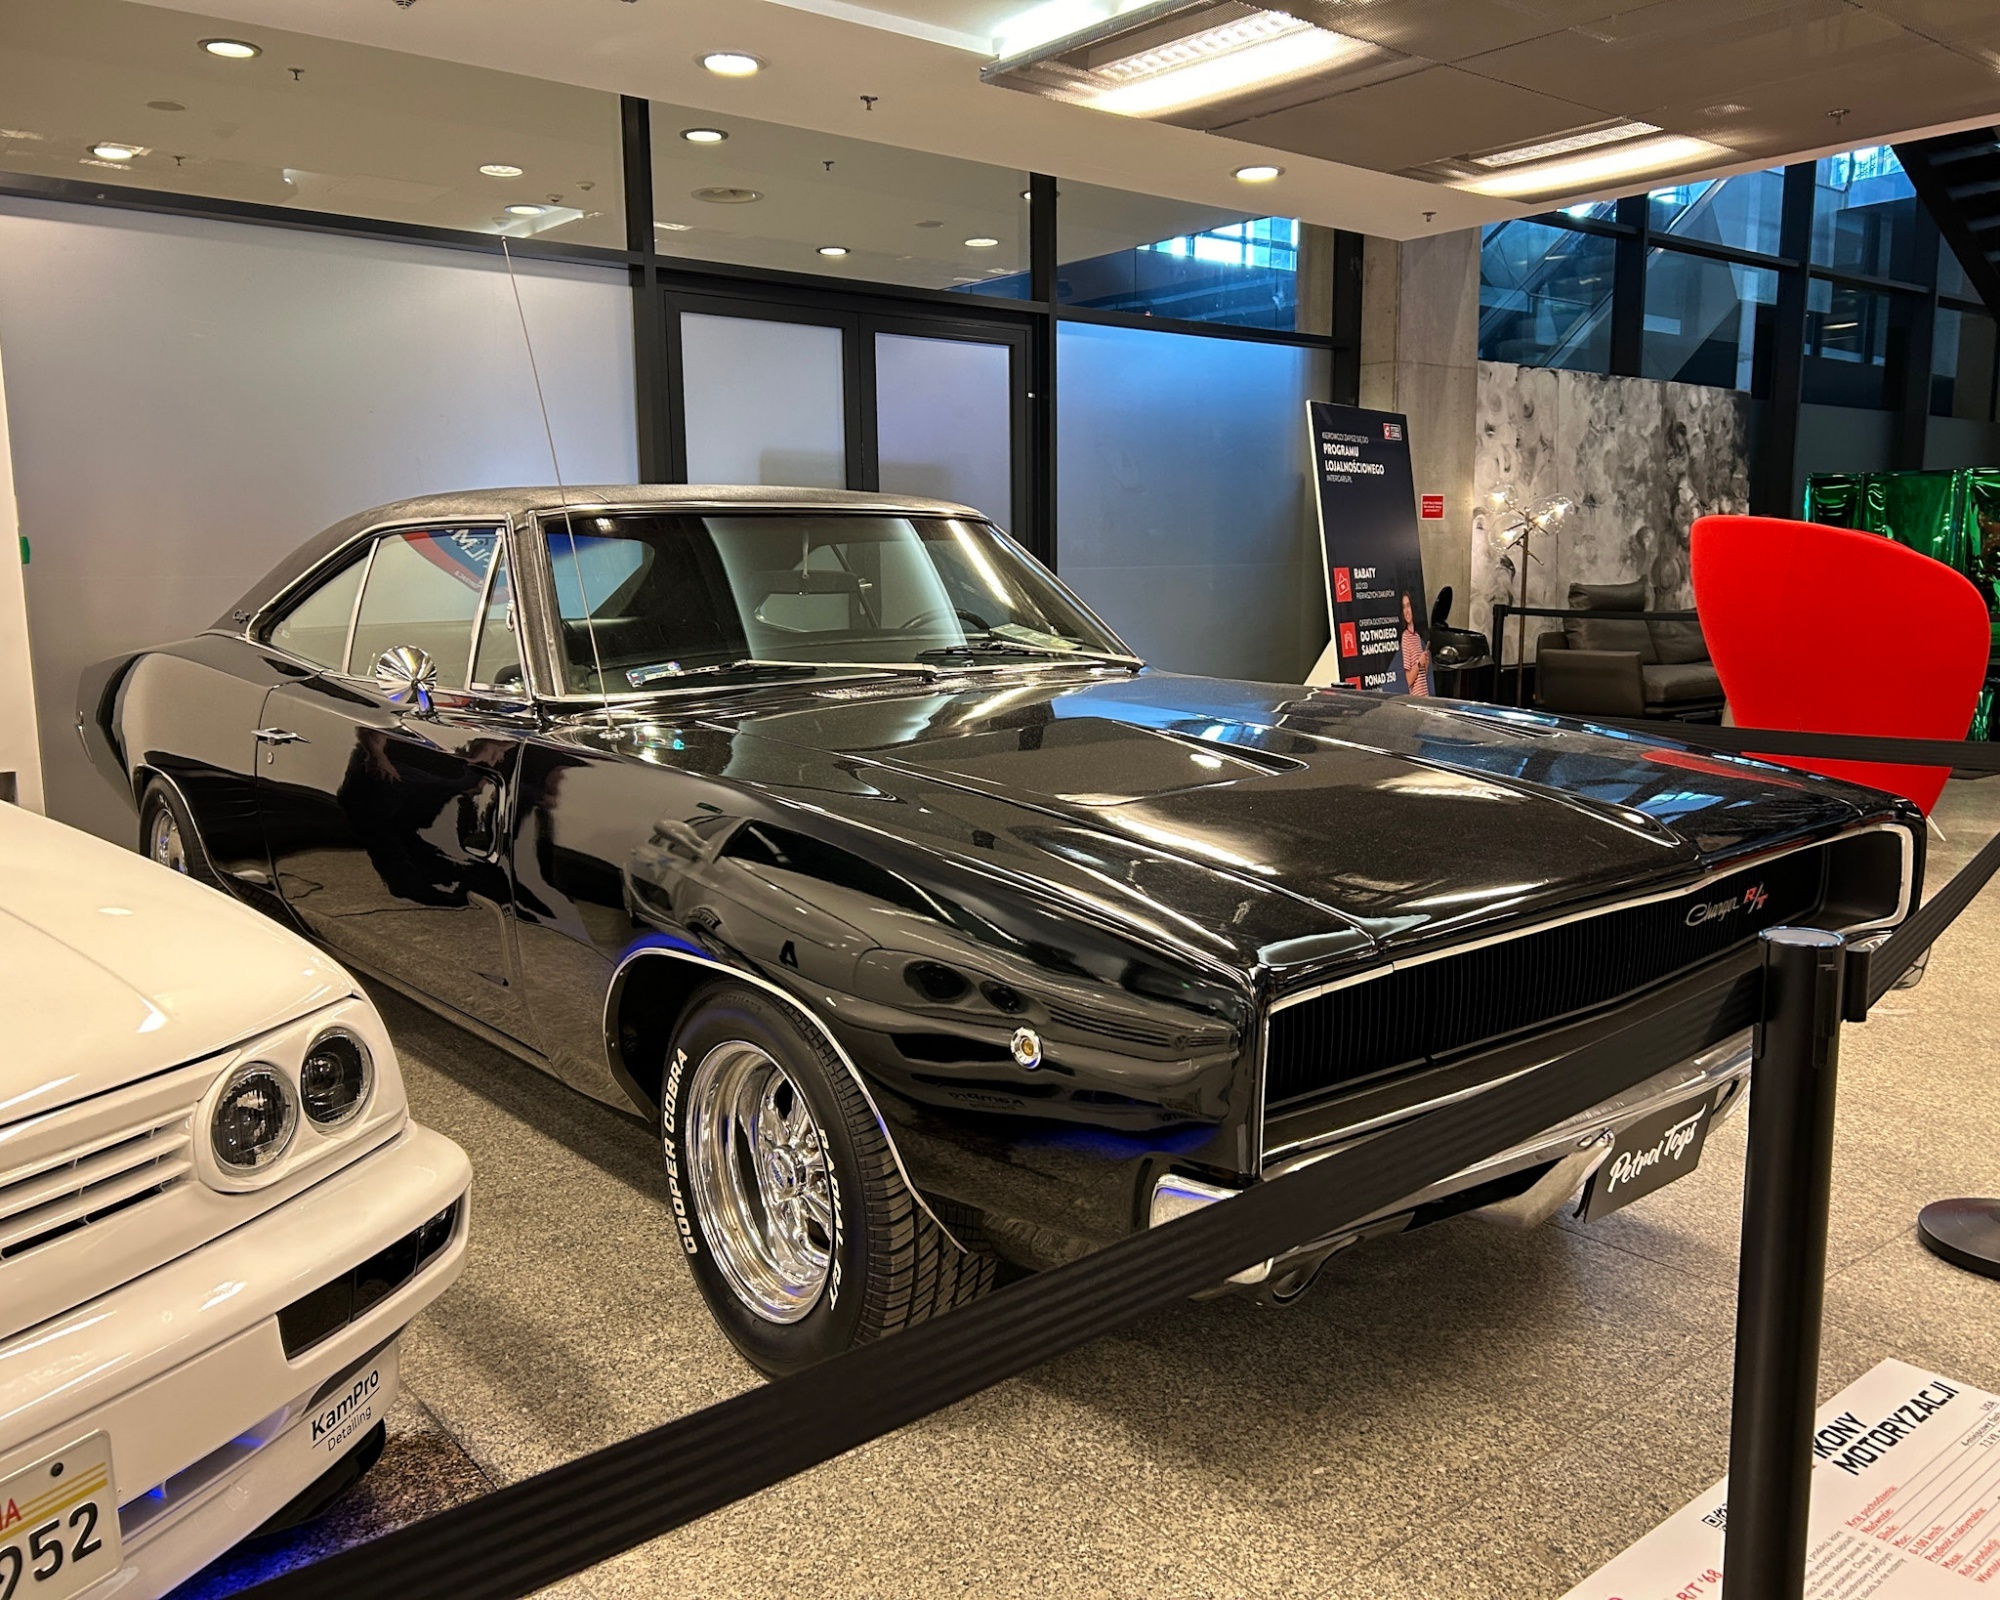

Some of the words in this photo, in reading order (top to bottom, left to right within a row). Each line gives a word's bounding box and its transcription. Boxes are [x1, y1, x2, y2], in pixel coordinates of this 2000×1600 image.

[1323, 443, 1359, 457] PROGRAMU
[1325, 459, 1385, 475] LOJALNOŚCIOWEGO
[1353, 567, 1376, 579] RABATY
[1360, 631, 1369, 642] DO
[1370, 628, 1397, 641] TWOJEGO
[1361, 641, 1399, 656] SAMOCHODU
[1365, 674, 1385, 687] PONAD
[1386, 672, 1397, 683] 250
[1743, 882, 1769, 914] R/T
[663, 1048, 688, 1133] COBRA
[1607, 1140, 1664, 1193] Petrol
[1664, 1103, 1707, 1160] Toys
[664, 1136, 698, 1254] COOPER
[819, 1128, 844, 1249] RADIAL
[311, 1369, 379, 1442] KamPro
[326, 1405, 373, 1452] Detailing
[1832, 1380, 1960, 1476] MOTORYZACJI
[1698, 1568, 1723, 1584] '68
